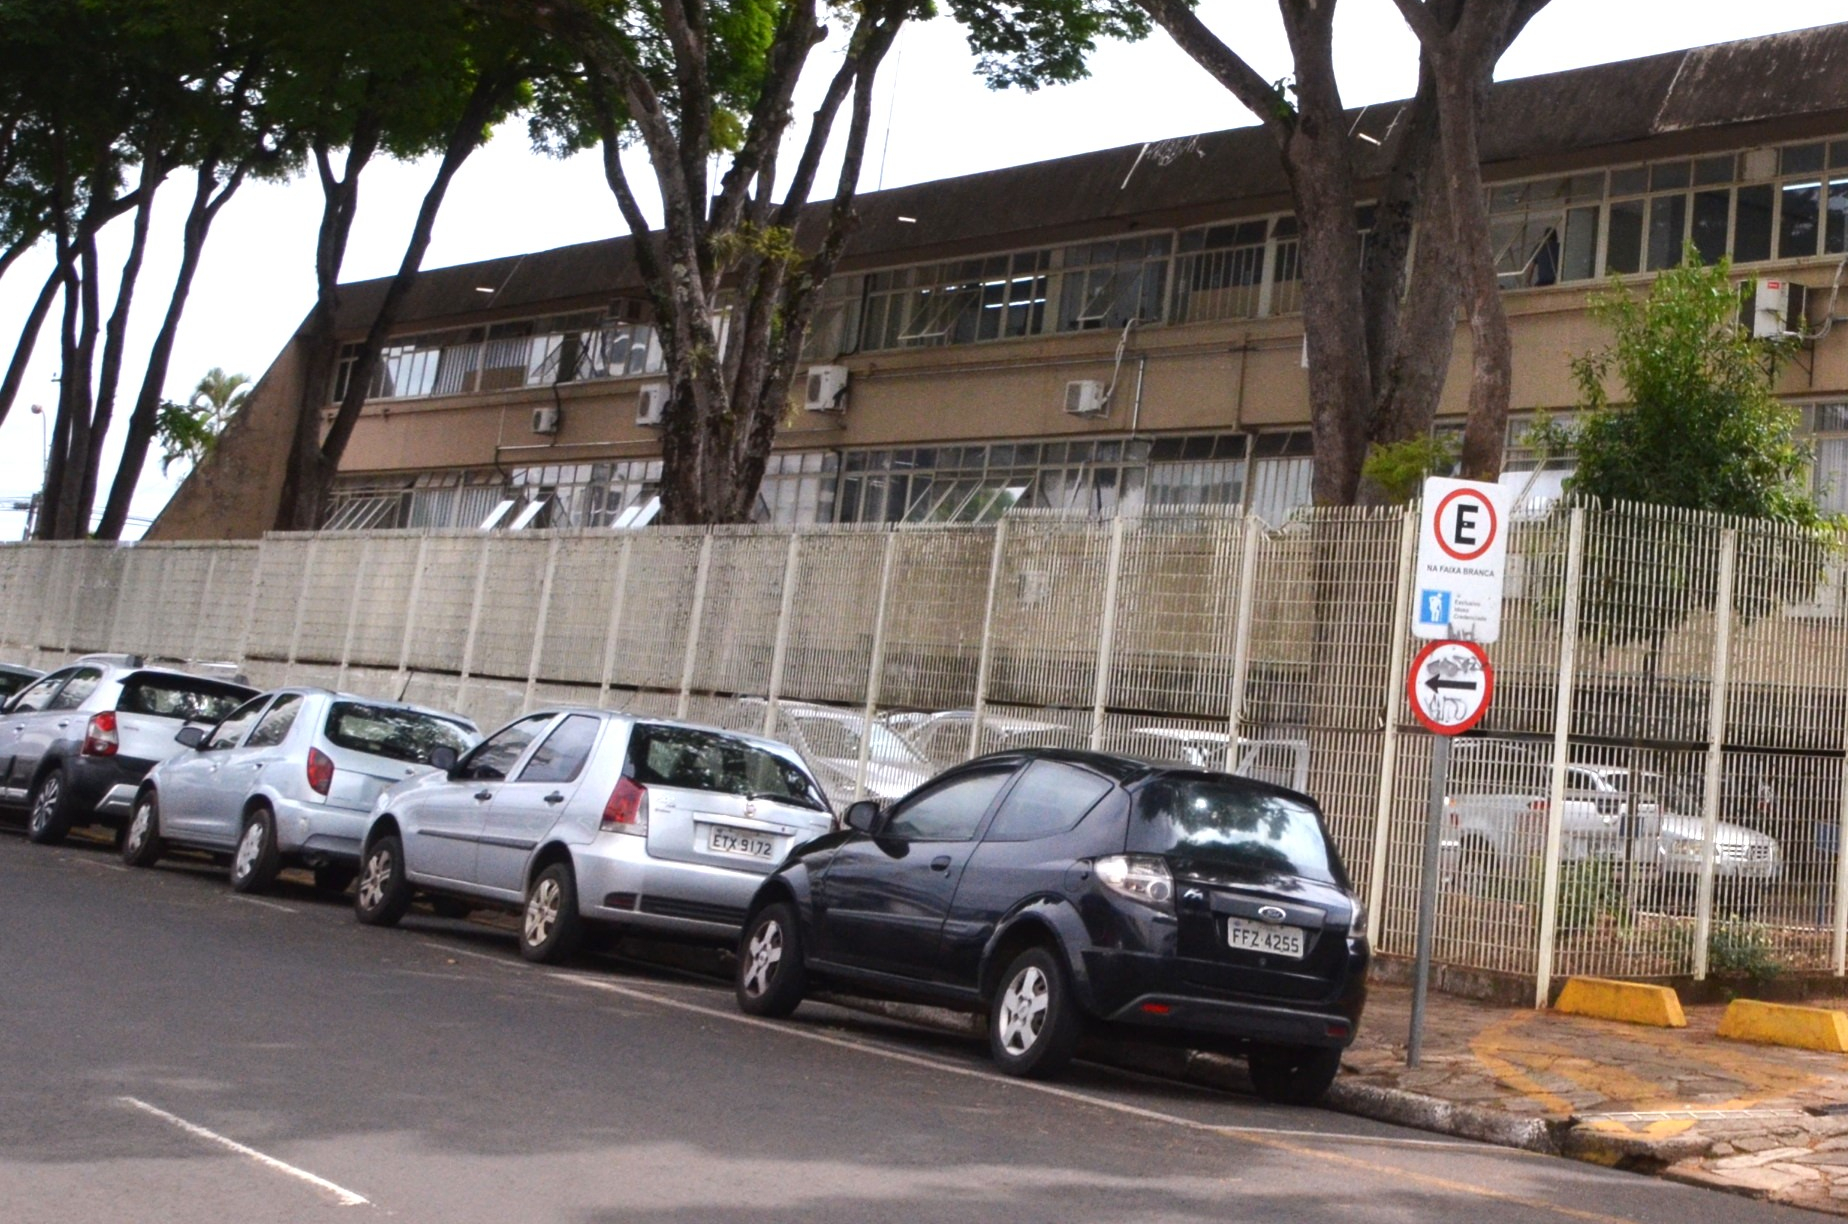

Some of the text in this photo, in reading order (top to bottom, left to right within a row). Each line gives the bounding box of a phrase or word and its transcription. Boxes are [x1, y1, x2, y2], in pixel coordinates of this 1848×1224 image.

[1454, 504, 1478, 545] E
[1427, 564, 1495, 577] NA FAIXA BRANCA
